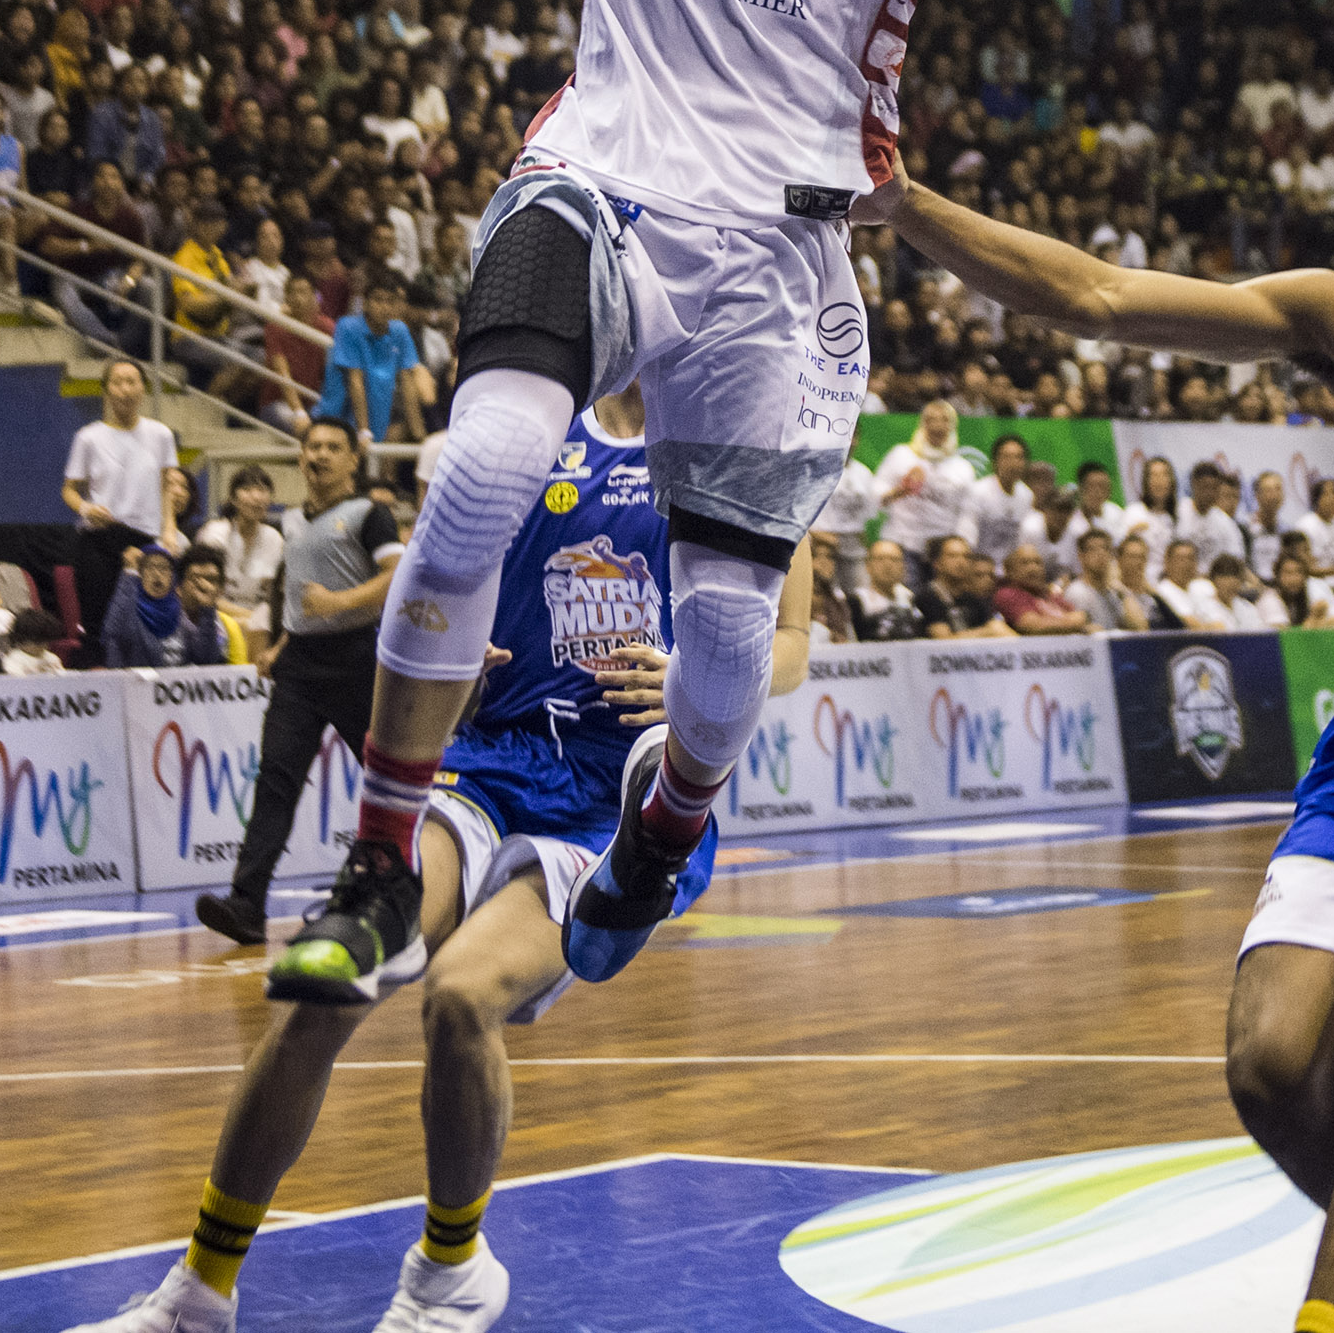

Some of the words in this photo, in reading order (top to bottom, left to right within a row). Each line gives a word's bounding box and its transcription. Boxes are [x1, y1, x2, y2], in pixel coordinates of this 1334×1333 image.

[805, 345, 825, 372] THE
[546, 572, 659, 604] SATRIA
[553, 600, 660, 636] MUDA
[154, 677, 268, 706] DOWNLOA
[14, 861, 122, 890] PERTAMINA
